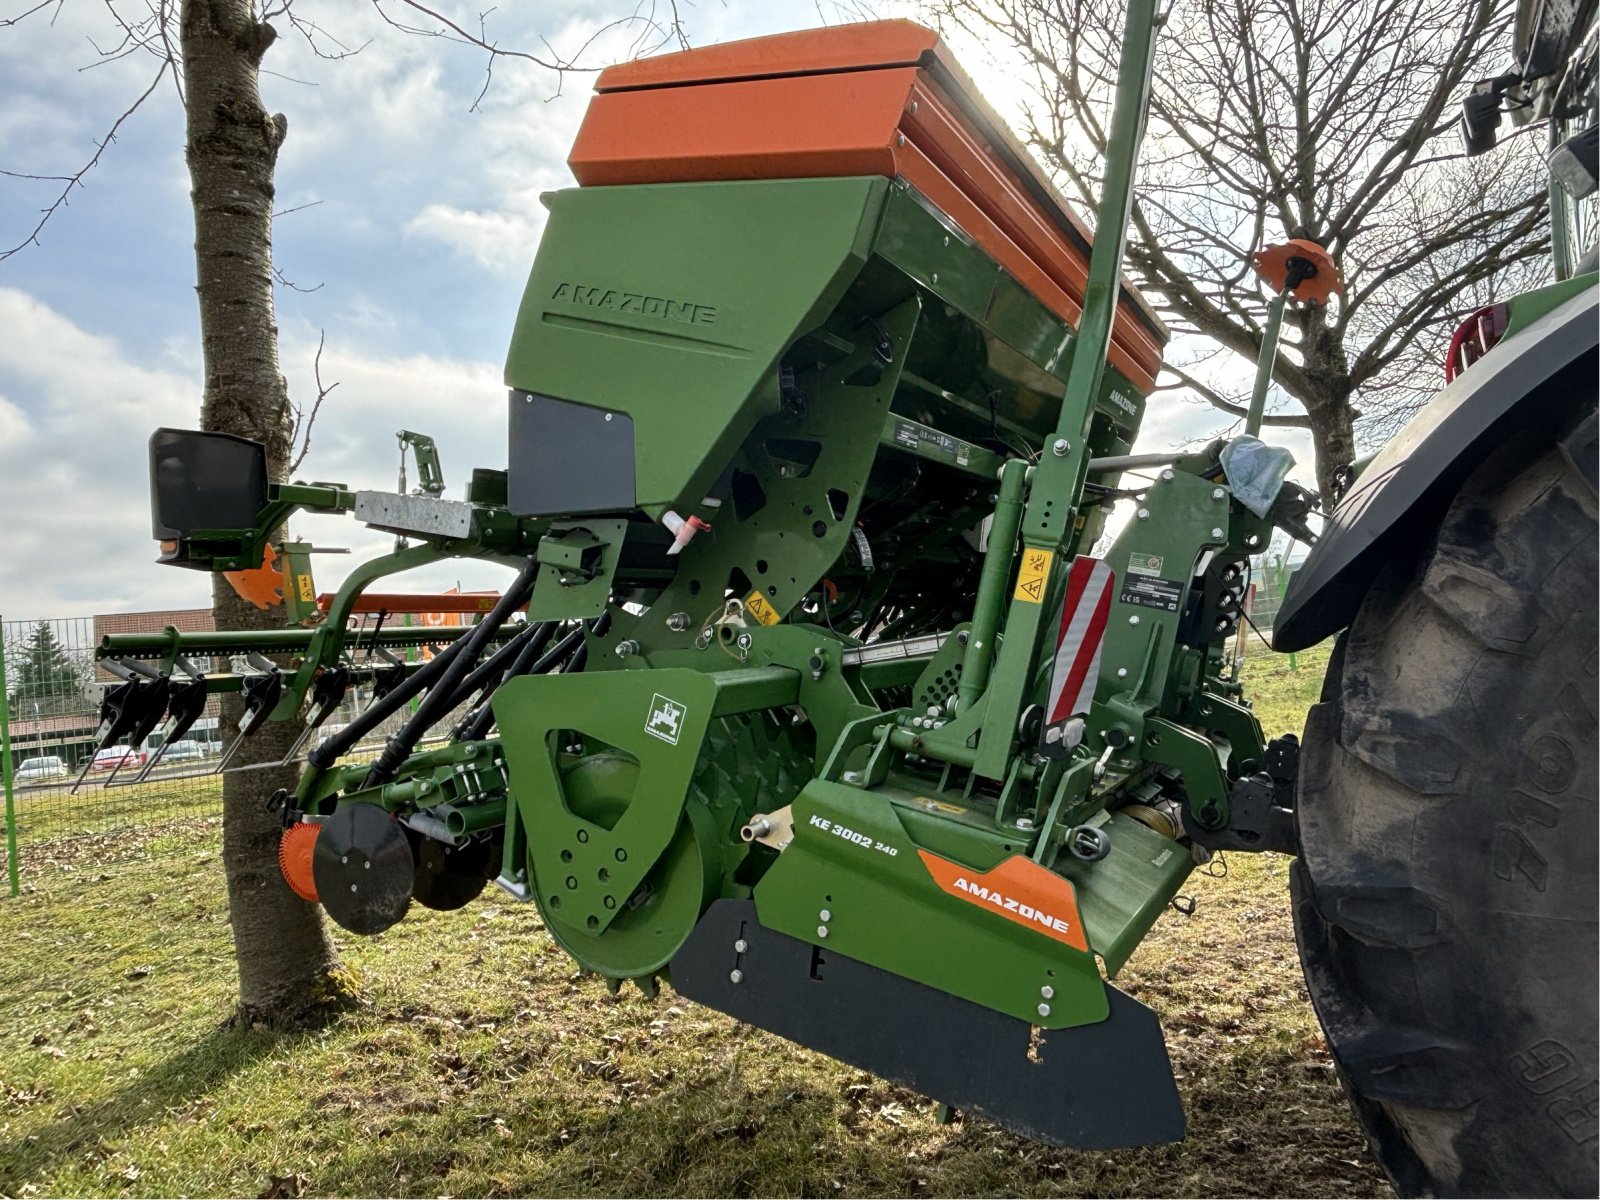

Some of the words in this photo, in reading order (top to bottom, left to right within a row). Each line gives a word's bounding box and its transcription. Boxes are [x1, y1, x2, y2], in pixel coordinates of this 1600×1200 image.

[551, 283, 717, 325] AMAZONE
[1109, 389, 1137, 416] AMAZONE
[809, 815, 830, 831] KE
[831, 824, 873, 849] 3002
[875, 841, 898, 857] 240
[953, 877, 1069, 935] AMAZONE
